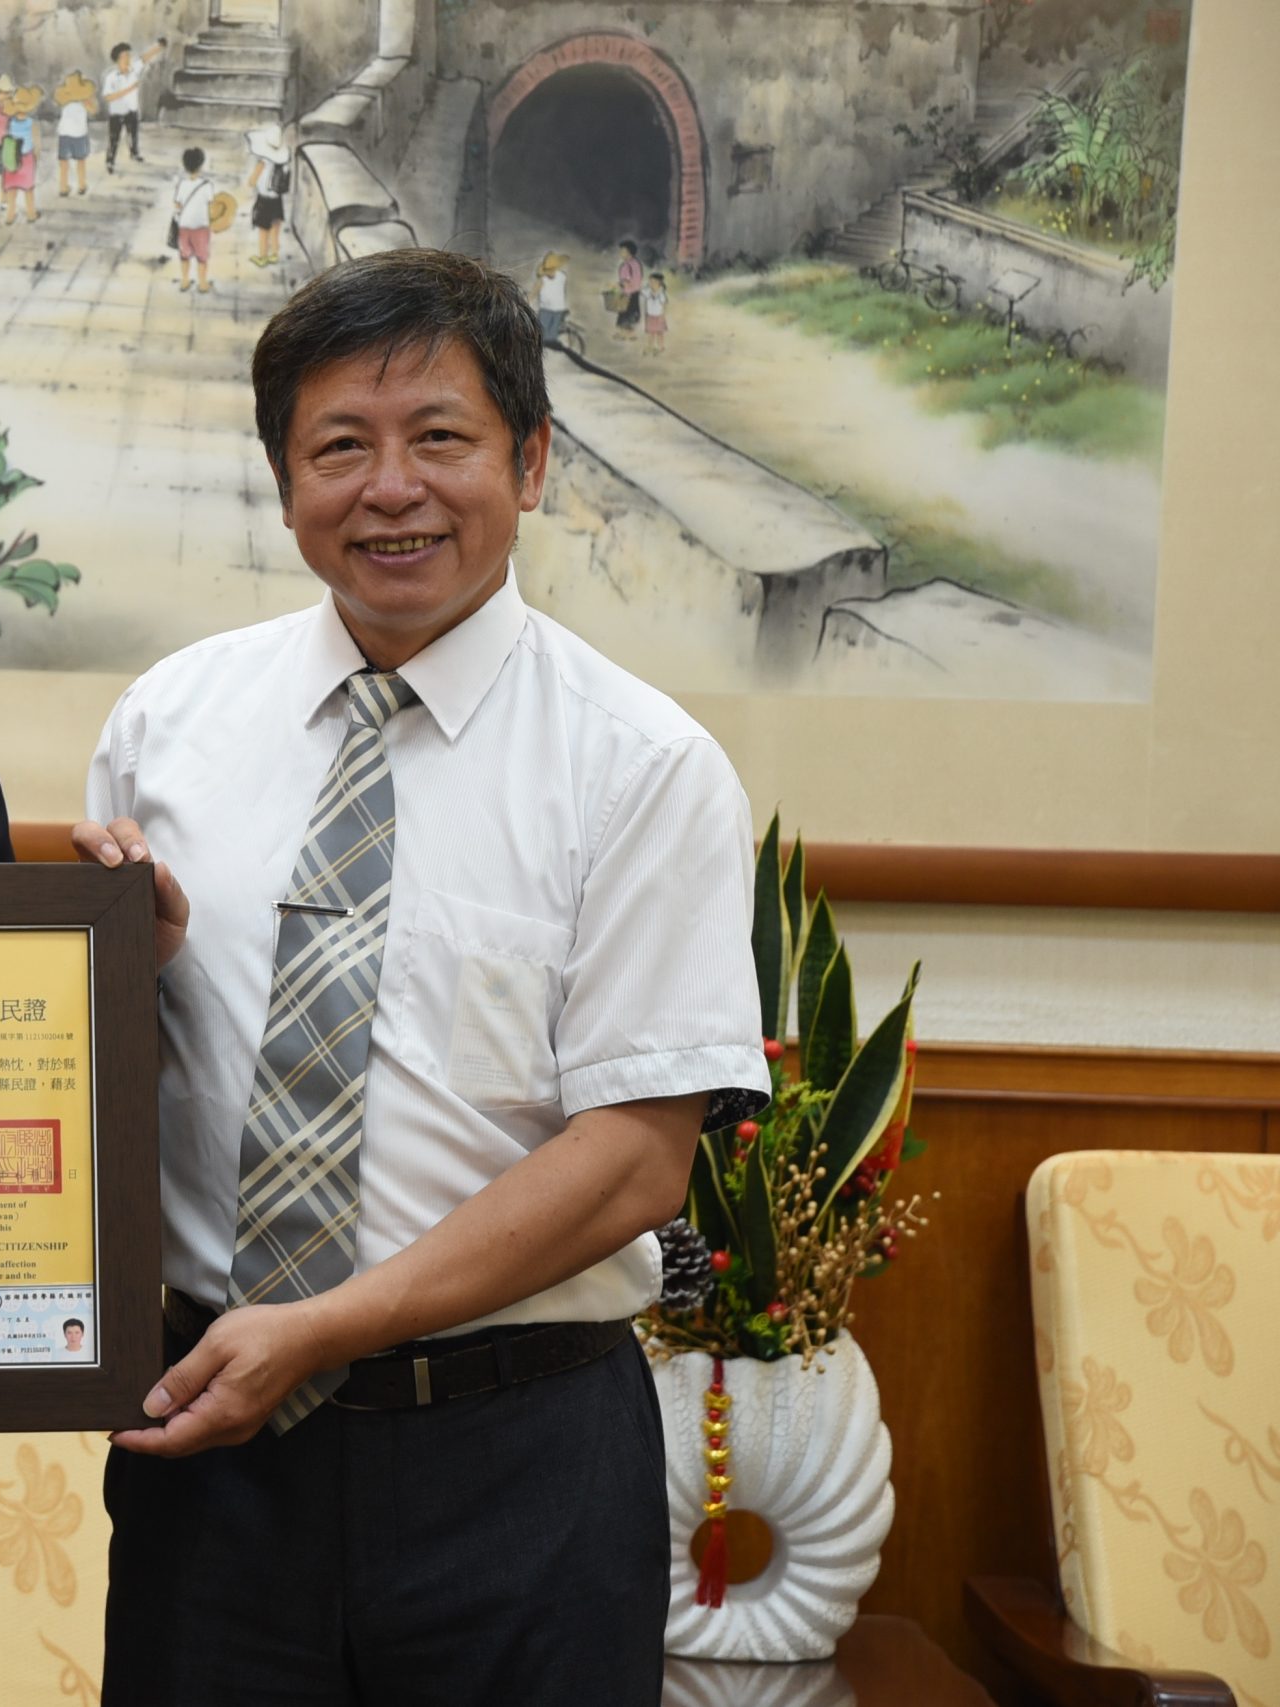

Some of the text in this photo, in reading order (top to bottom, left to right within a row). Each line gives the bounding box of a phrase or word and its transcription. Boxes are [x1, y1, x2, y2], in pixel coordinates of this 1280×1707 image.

[19, 1201, 27, 1209] of
[0, 1260, 37, 1269] affection
[5, 1272, 21, 1280] and
[23, 1272, 37, 1280] the
